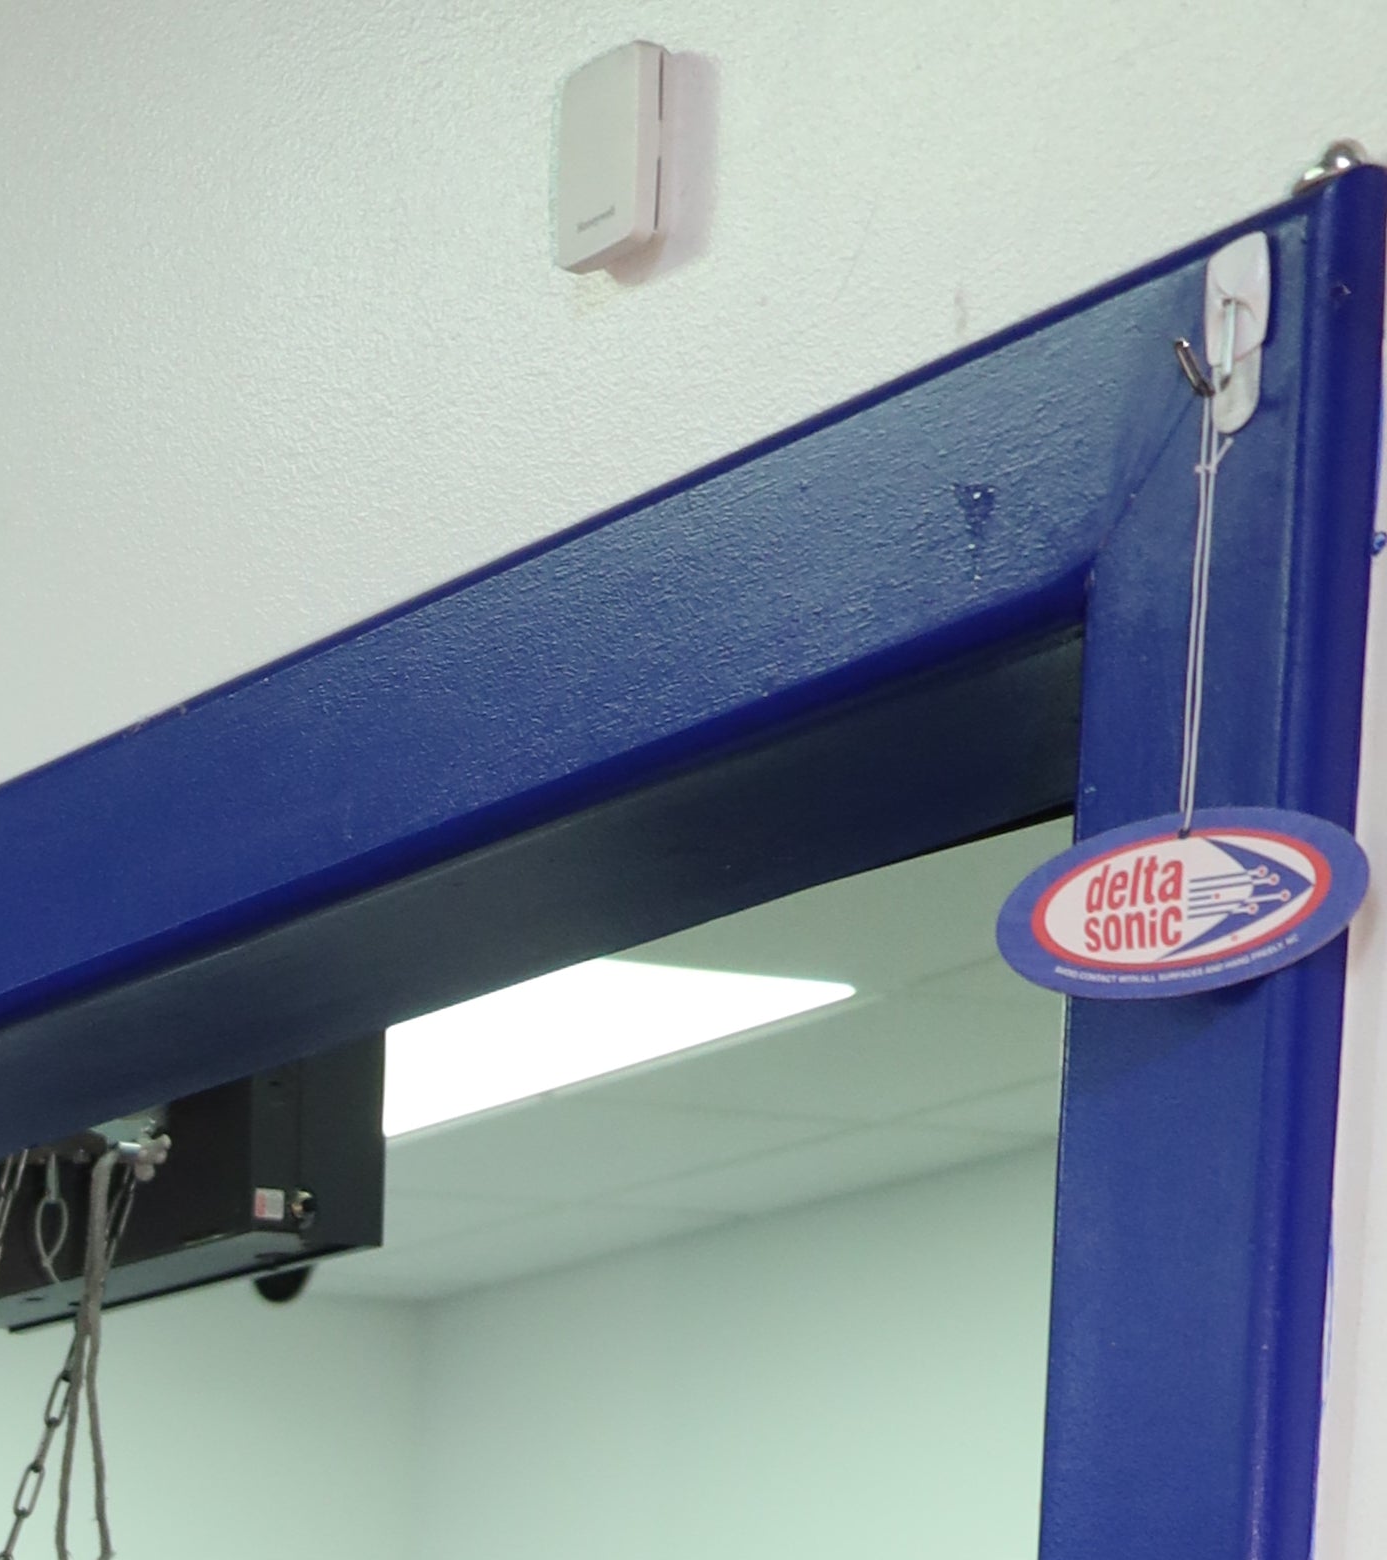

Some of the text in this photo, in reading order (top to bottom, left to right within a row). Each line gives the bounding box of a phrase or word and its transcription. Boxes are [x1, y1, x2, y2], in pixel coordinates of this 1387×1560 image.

[1086, 855, 1183, 913] delta
[1084, 906, 1182, 952] sonic
[1079, 971, 1117, 984] CONTACT
[1118, 974, 1140, 984] WITH
[1141, 974, 1156, 983] ALL
[1158, 968, 1203, 982] SURFACES
